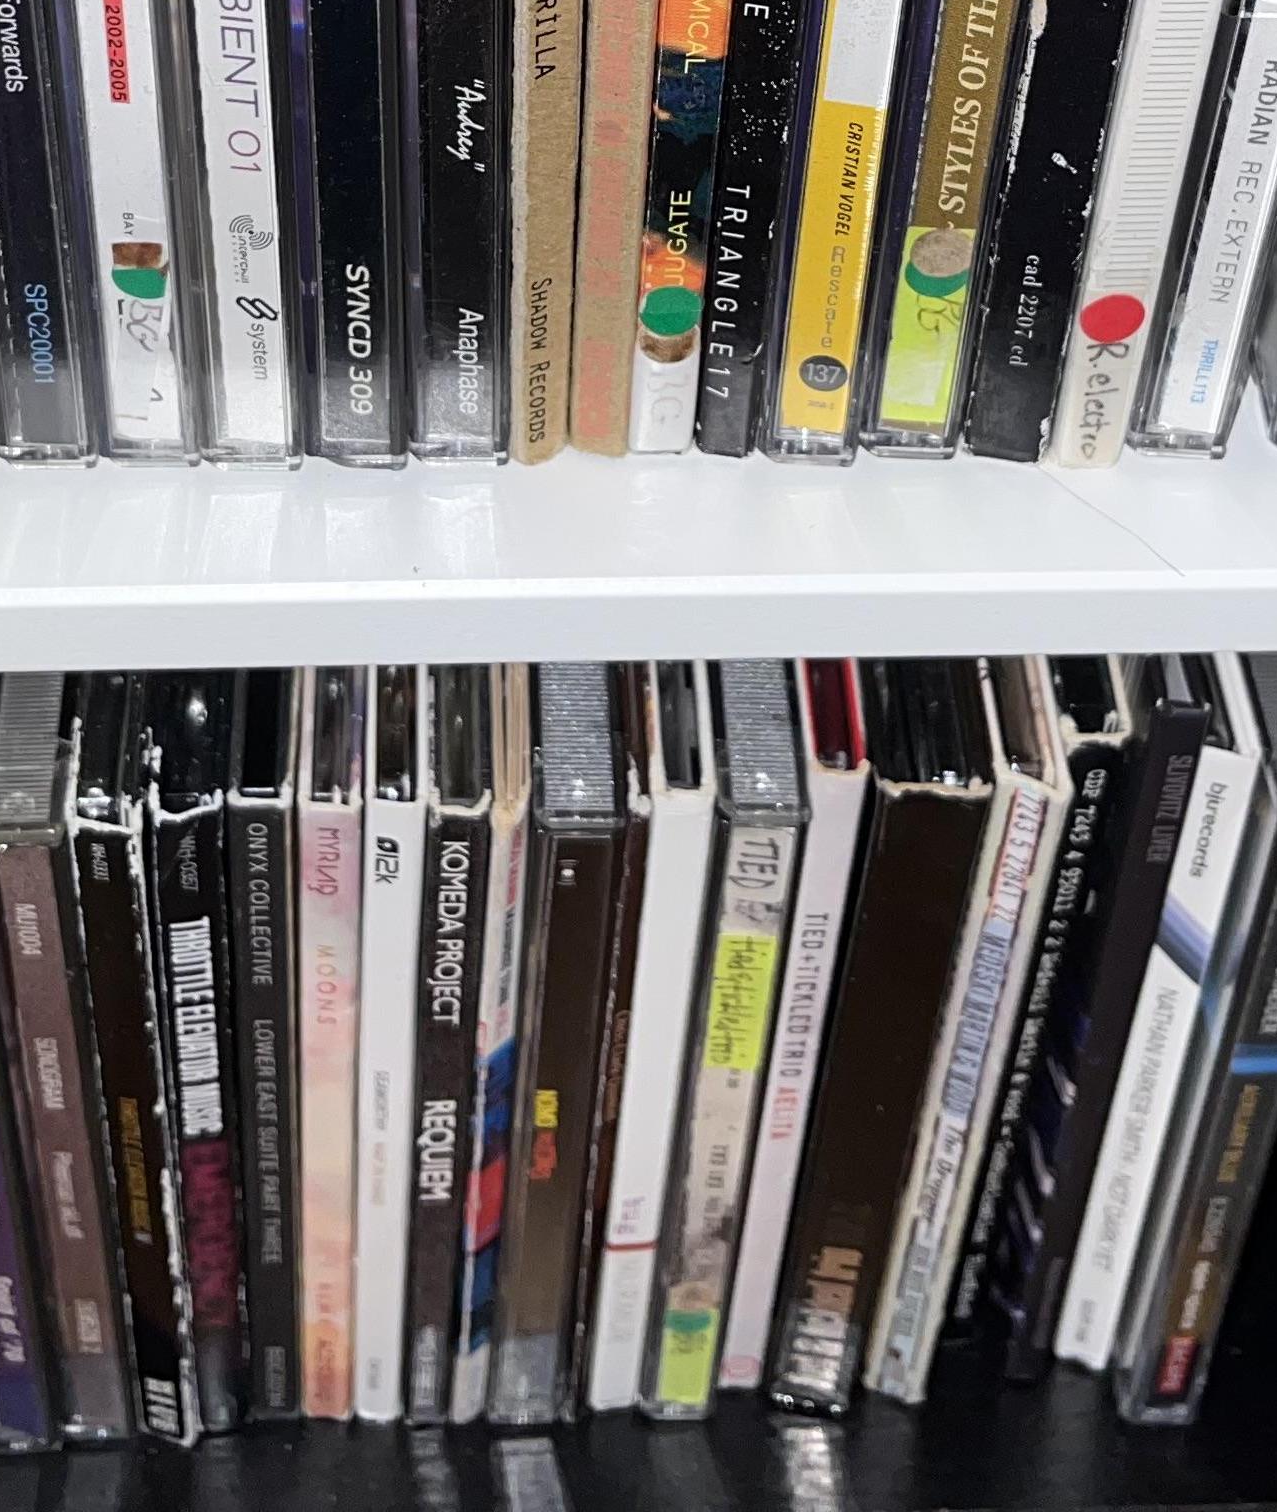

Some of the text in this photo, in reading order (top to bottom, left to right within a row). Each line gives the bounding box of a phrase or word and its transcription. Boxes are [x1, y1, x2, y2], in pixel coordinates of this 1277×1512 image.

[104, 4, 128, 102] 2002-2005
[957, 42, 989, 90] OF
[834, 121, 864, 236] CRISTIAN VOGEL
[937, 96, 982, 215] STYLES
[1208, 160, 1264, 304] REC.EXTERN
[23, 283, 59, 387] SPC20001
[345, 263, 374, 416] SYNCD 309
[1013, 254, 1042, 340] cad 2207
[246, 322, 269, 380] system
[451, 306, 487, 417] Anaphase
[245, 822, 274, 985] ONYX COLLECTIVE
[430, 840, 471, 1026] KOMEDA PROJECT
[800, 912, 830, 950] TIED
[169, 915, 215, 1004] THROTTLE
[315, 944, 338, 1025] MOONS
[175, 1002, 220, 1083] ELEVATOR
[253, 1018, 277, 1077] LOWER
[779, 1040, 807, 1078] TRIO
[181, 1081, 224, 1136] MUSIC
[255, 1081, 278, 1122] EAST
[415, 1099, 458, 1201] REQUIEM
